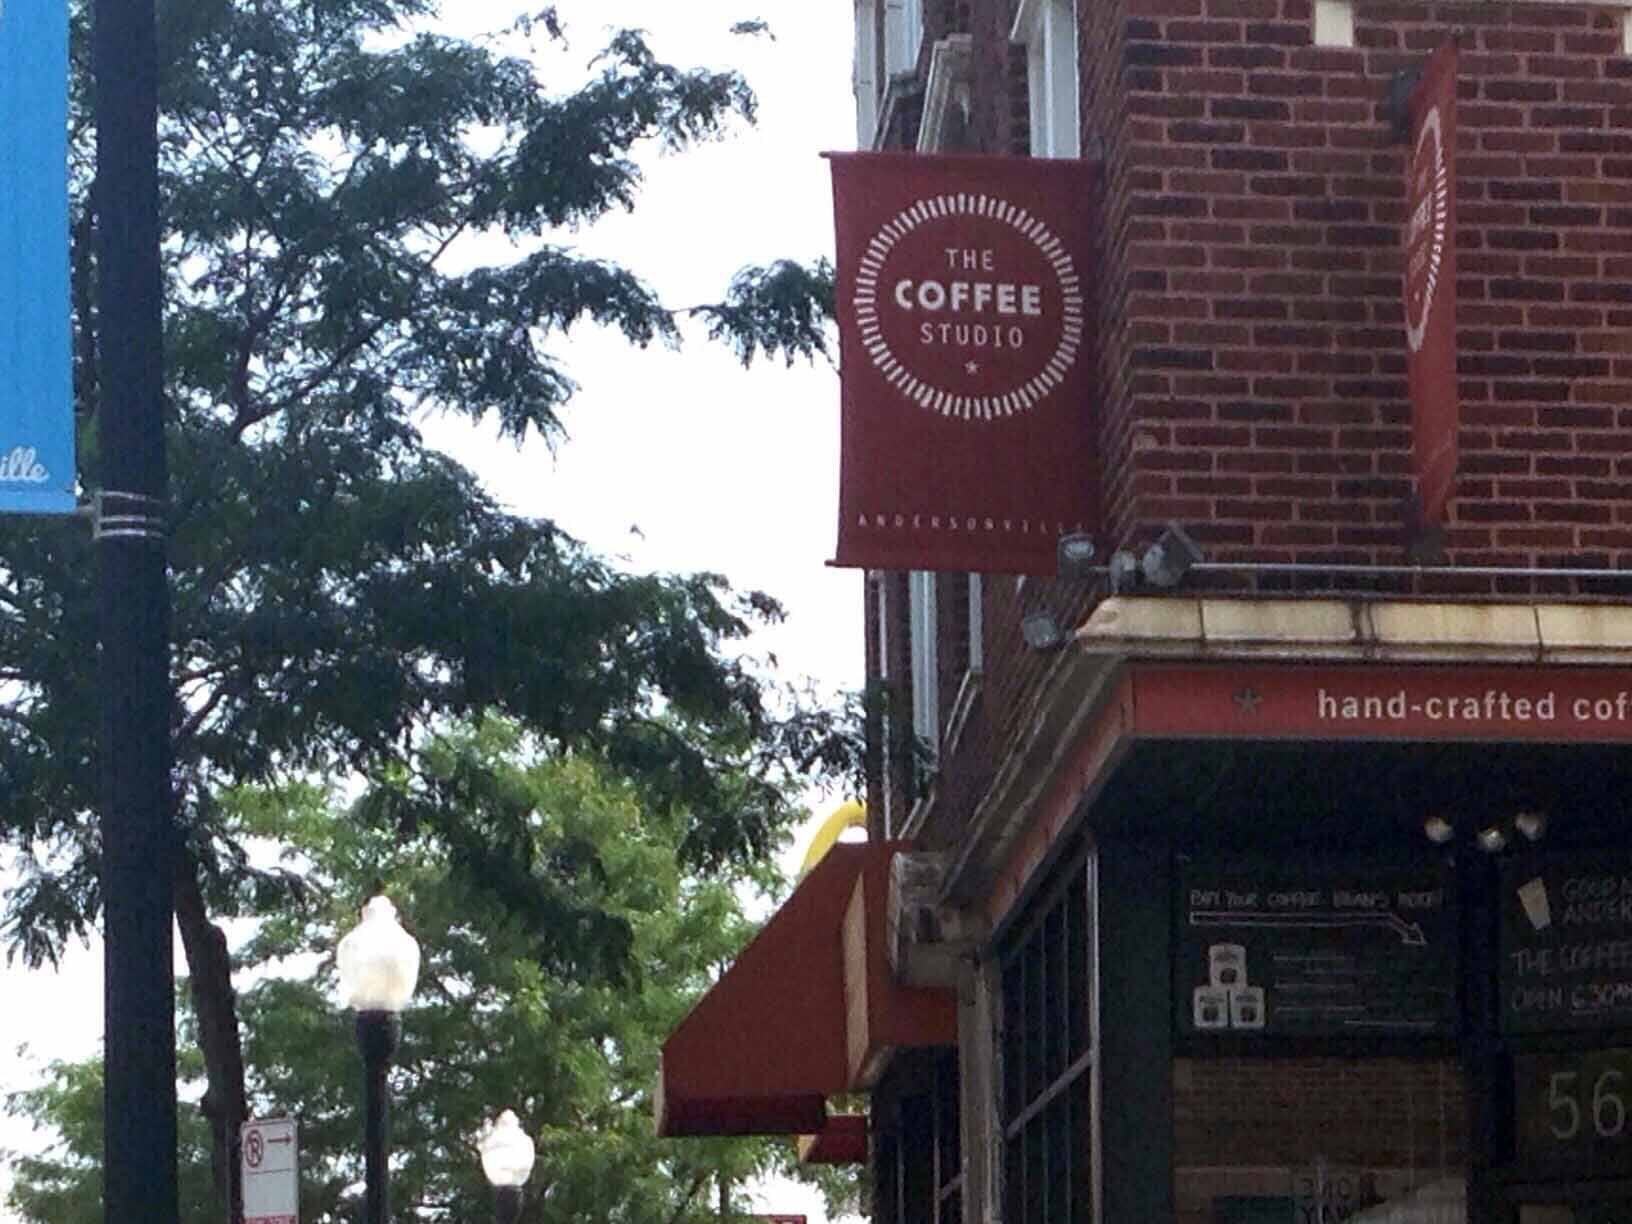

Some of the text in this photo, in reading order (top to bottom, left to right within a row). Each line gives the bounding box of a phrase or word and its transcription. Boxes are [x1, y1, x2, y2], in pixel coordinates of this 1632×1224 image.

[945, 248, 995, 272] THE
[895, 279, 1042, 316] COFFEE
[920, 323, 1025, 350] STUDIO
[1317, 689, 1556, 721] hand-crafted
